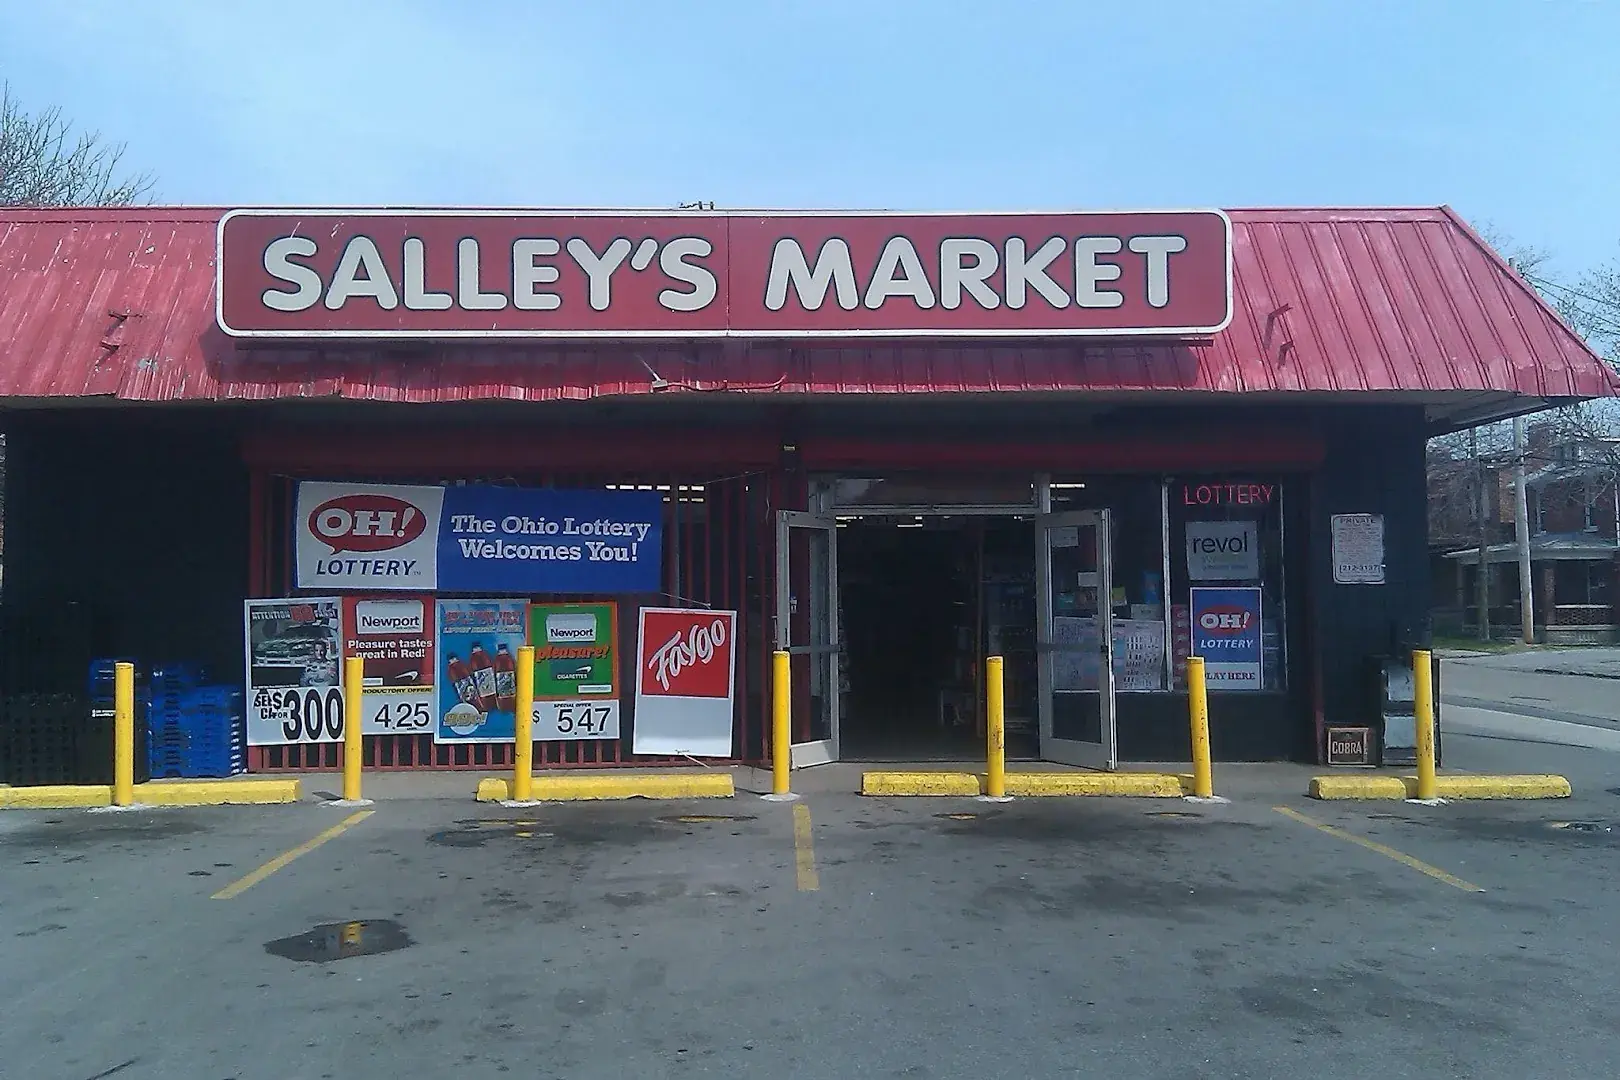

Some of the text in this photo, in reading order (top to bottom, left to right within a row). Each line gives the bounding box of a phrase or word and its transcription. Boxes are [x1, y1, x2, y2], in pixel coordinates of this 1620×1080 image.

[262, 236, 1187, 311] SALLEY'S MARKET
[1183, 484, 1274, 505] LOTTERY
[316, 506, 415, 538] OH!
[451, 515, 651, 542] The Ohio Lottery
[458, 538, 637, 562] Welcomes You!
[1193, 531, 1249, 554] revol
[316, 560, 417, 576] LOTTERY
[252, 611, 291, 620] ATTENTION
[361, 616, 420, 628] Newport
[1200, 611, 1250, 629] OH!
[550, 628, 594, 638] Newport
[347, 639, 433, 649] Pleasure tastes
[1200, 640, 1254, 649] LOTTERY
[387, 650, 398, 658] in
[400, 649, 425, 658] Red!
[648, 619, 726, 691] Faygo
[1227, 672, 1256, 680] HERE
[374, 703, 430, 729] 4.25
[532, 707, 612, 736] $ 5.47
[1332, 741, 1362, 754] COBRA
